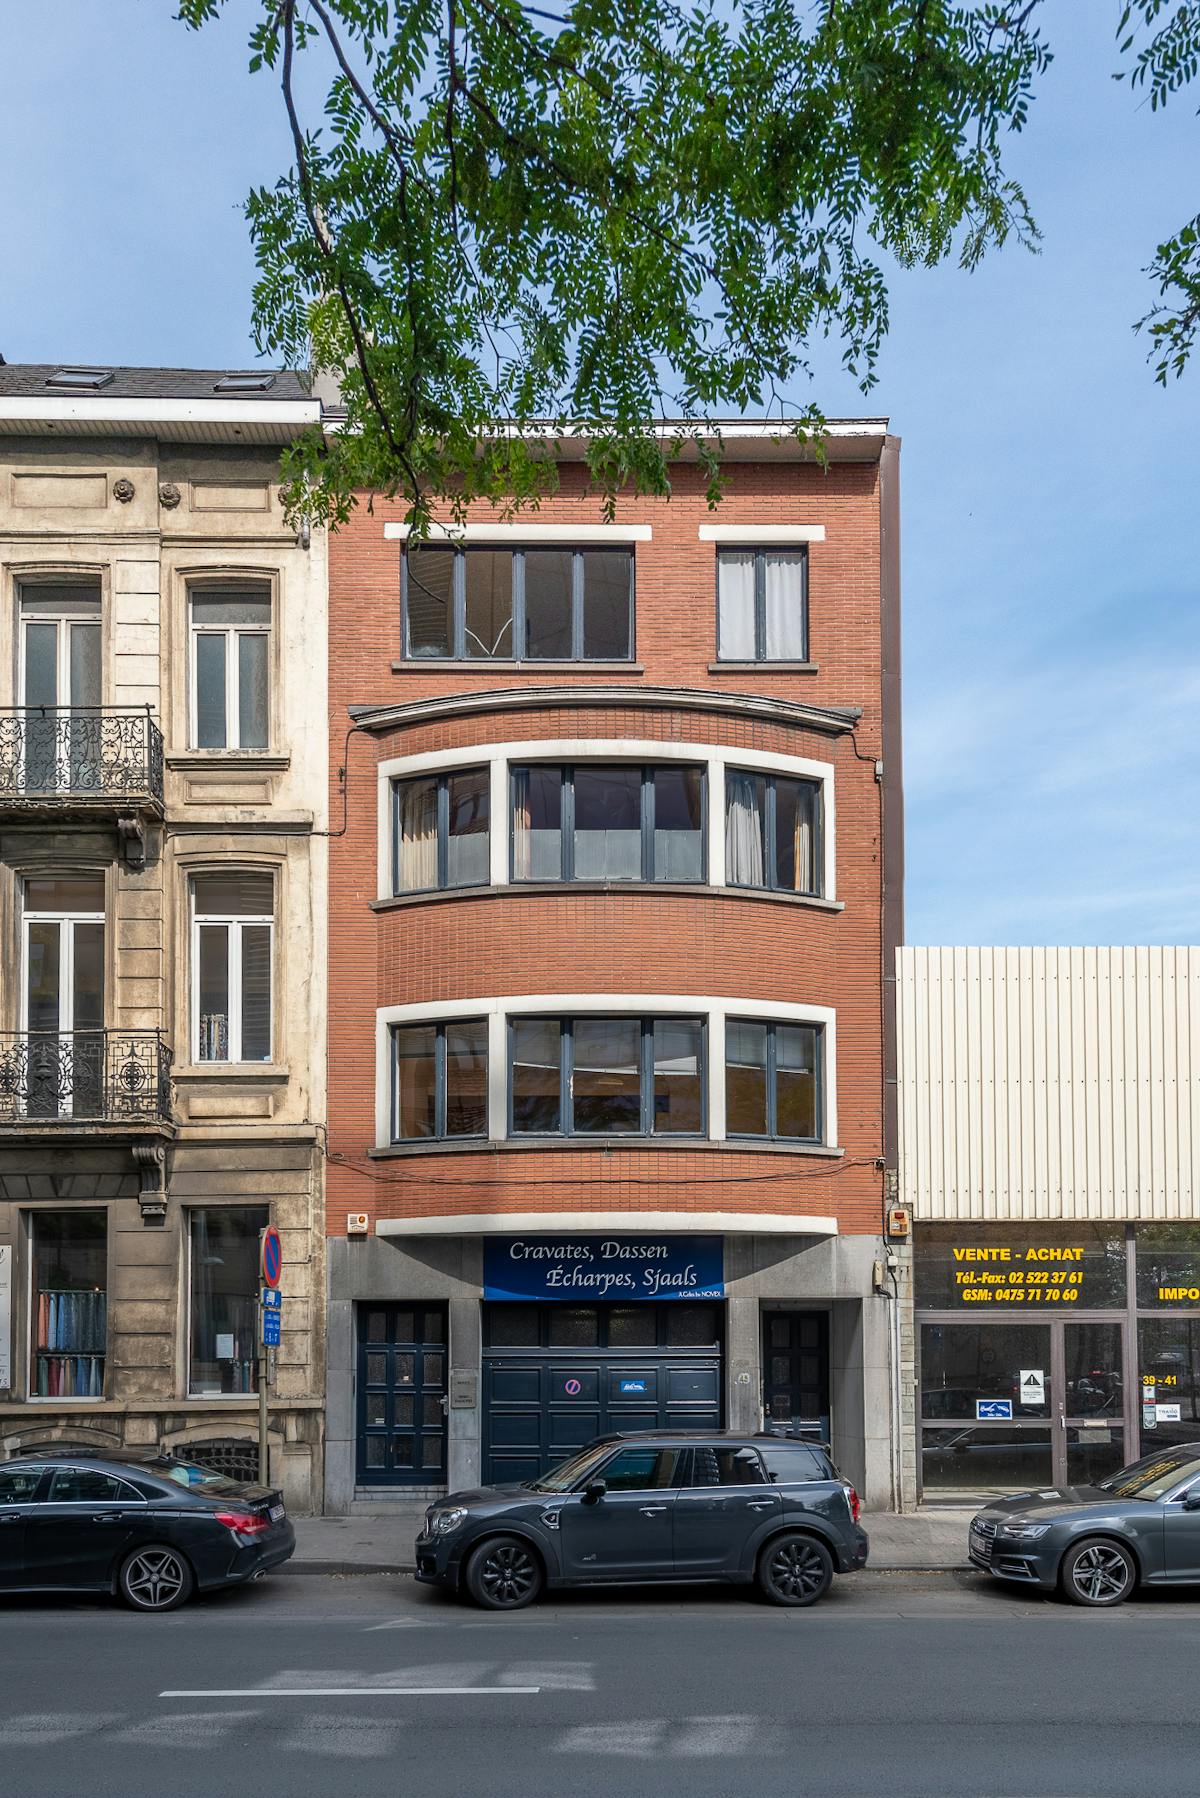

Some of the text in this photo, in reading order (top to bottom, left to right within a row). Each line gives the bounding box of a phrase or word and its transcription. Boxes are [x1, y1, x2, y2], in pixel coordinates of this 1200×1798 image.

[509, 1241, 669, 1262] Cravates, Dassen
[953, 1248, 1011, 1261] VENTE
[1026, 1248, 1084, 1261] ACHAT
[546, 1264, 698, 1295] Écharpes, Sjaals
[955, 1271, 1083, 1284] Tél.-Fax: 02 522 37 61
[962, 1288, 1078, 1301] GSM: 0475 71 70 60
[1158, 1287, 1200, 1300] IMPO
[1142, 1375, 1156, 1385] 39
[1164, 1375, 1177, 1385] 41
